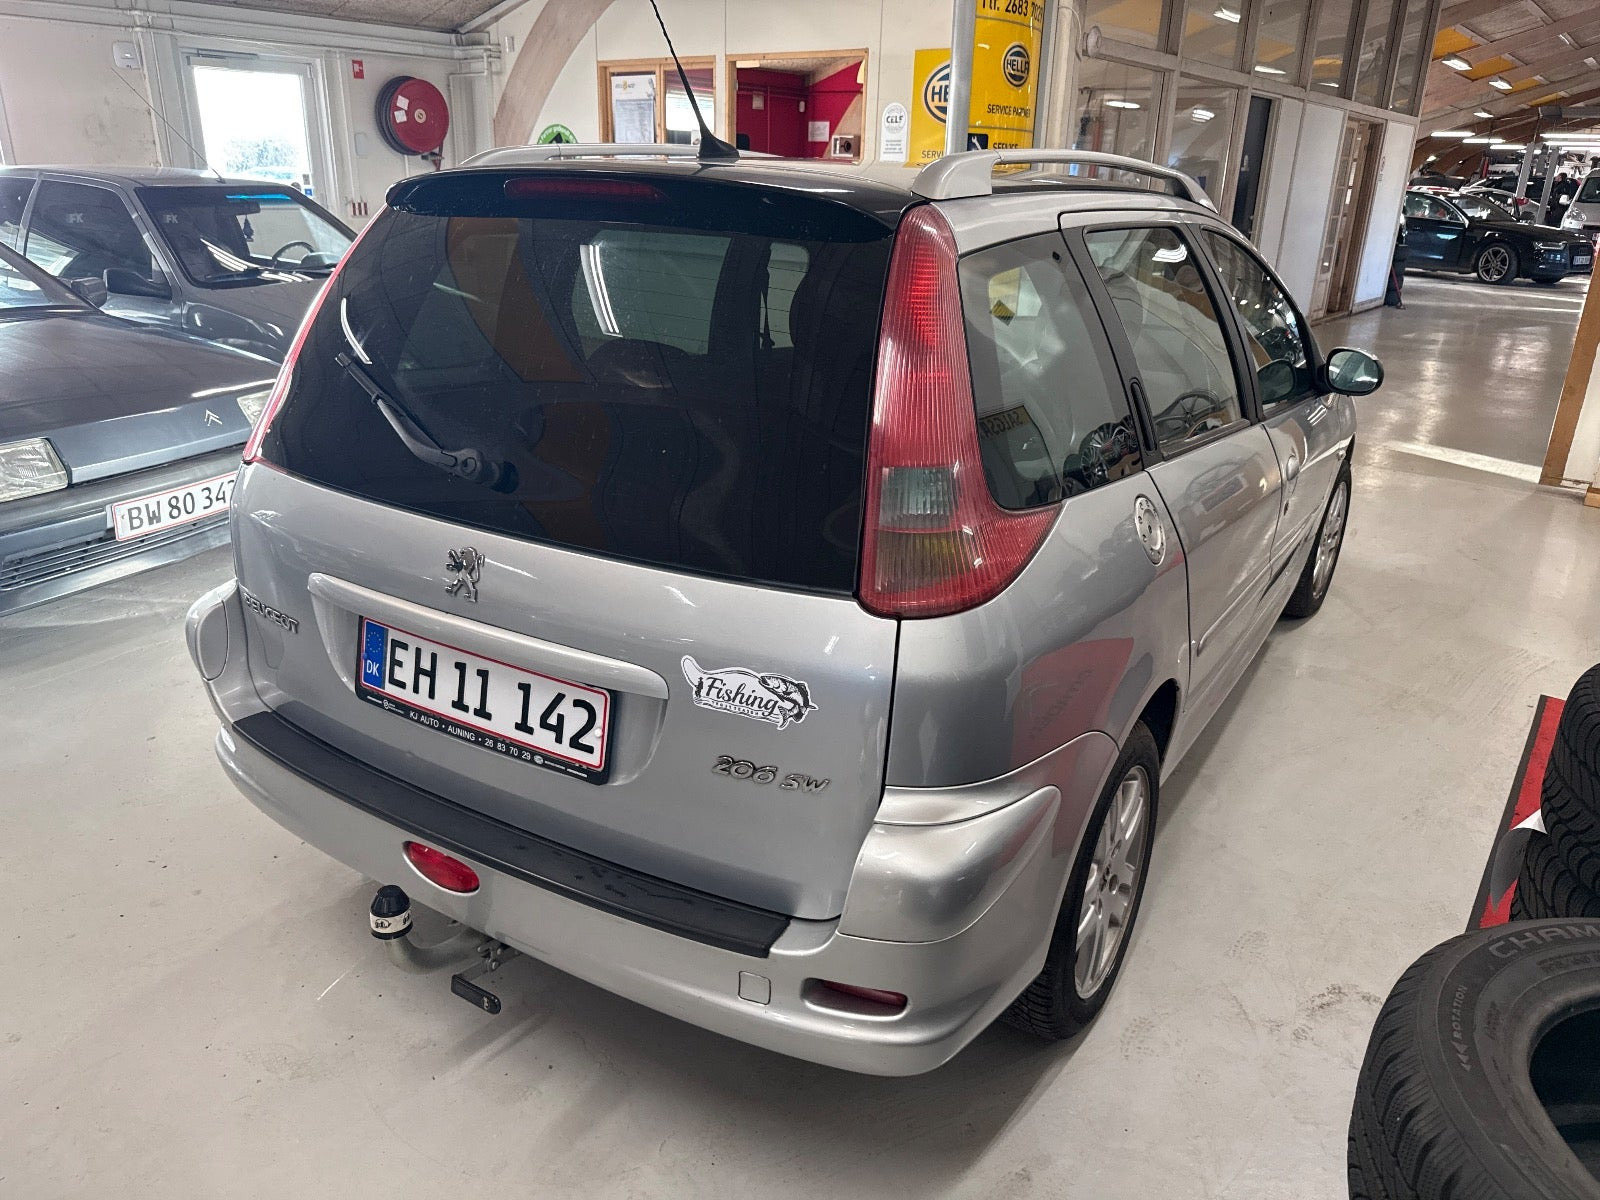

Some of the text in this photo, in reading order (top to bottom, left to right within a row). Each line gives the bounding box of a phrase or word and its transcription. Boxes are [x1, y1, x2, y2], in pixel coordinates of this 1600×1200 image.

[1005, 0, 1028, 17] 2683
[1006, 58, 1029, 75] HELLA
[987, 104, 1012, 116] SERVICE
[127, 500, 162, 531] BW
[167, 491, 196, 520] 80
[366, 659, 380, 677] DK
[388, 638, 598, 755] EH 11 142
[705, 676, 779, 717] Fishing
[409, 710, 531, 761] KJ AUTO AUNING 26 83 70 29
[712, 755, 831, 794] 206 SW
[1488, 924, 1600, 959] CHAM
[1453, 984, 1469, 1040] ROTATION
